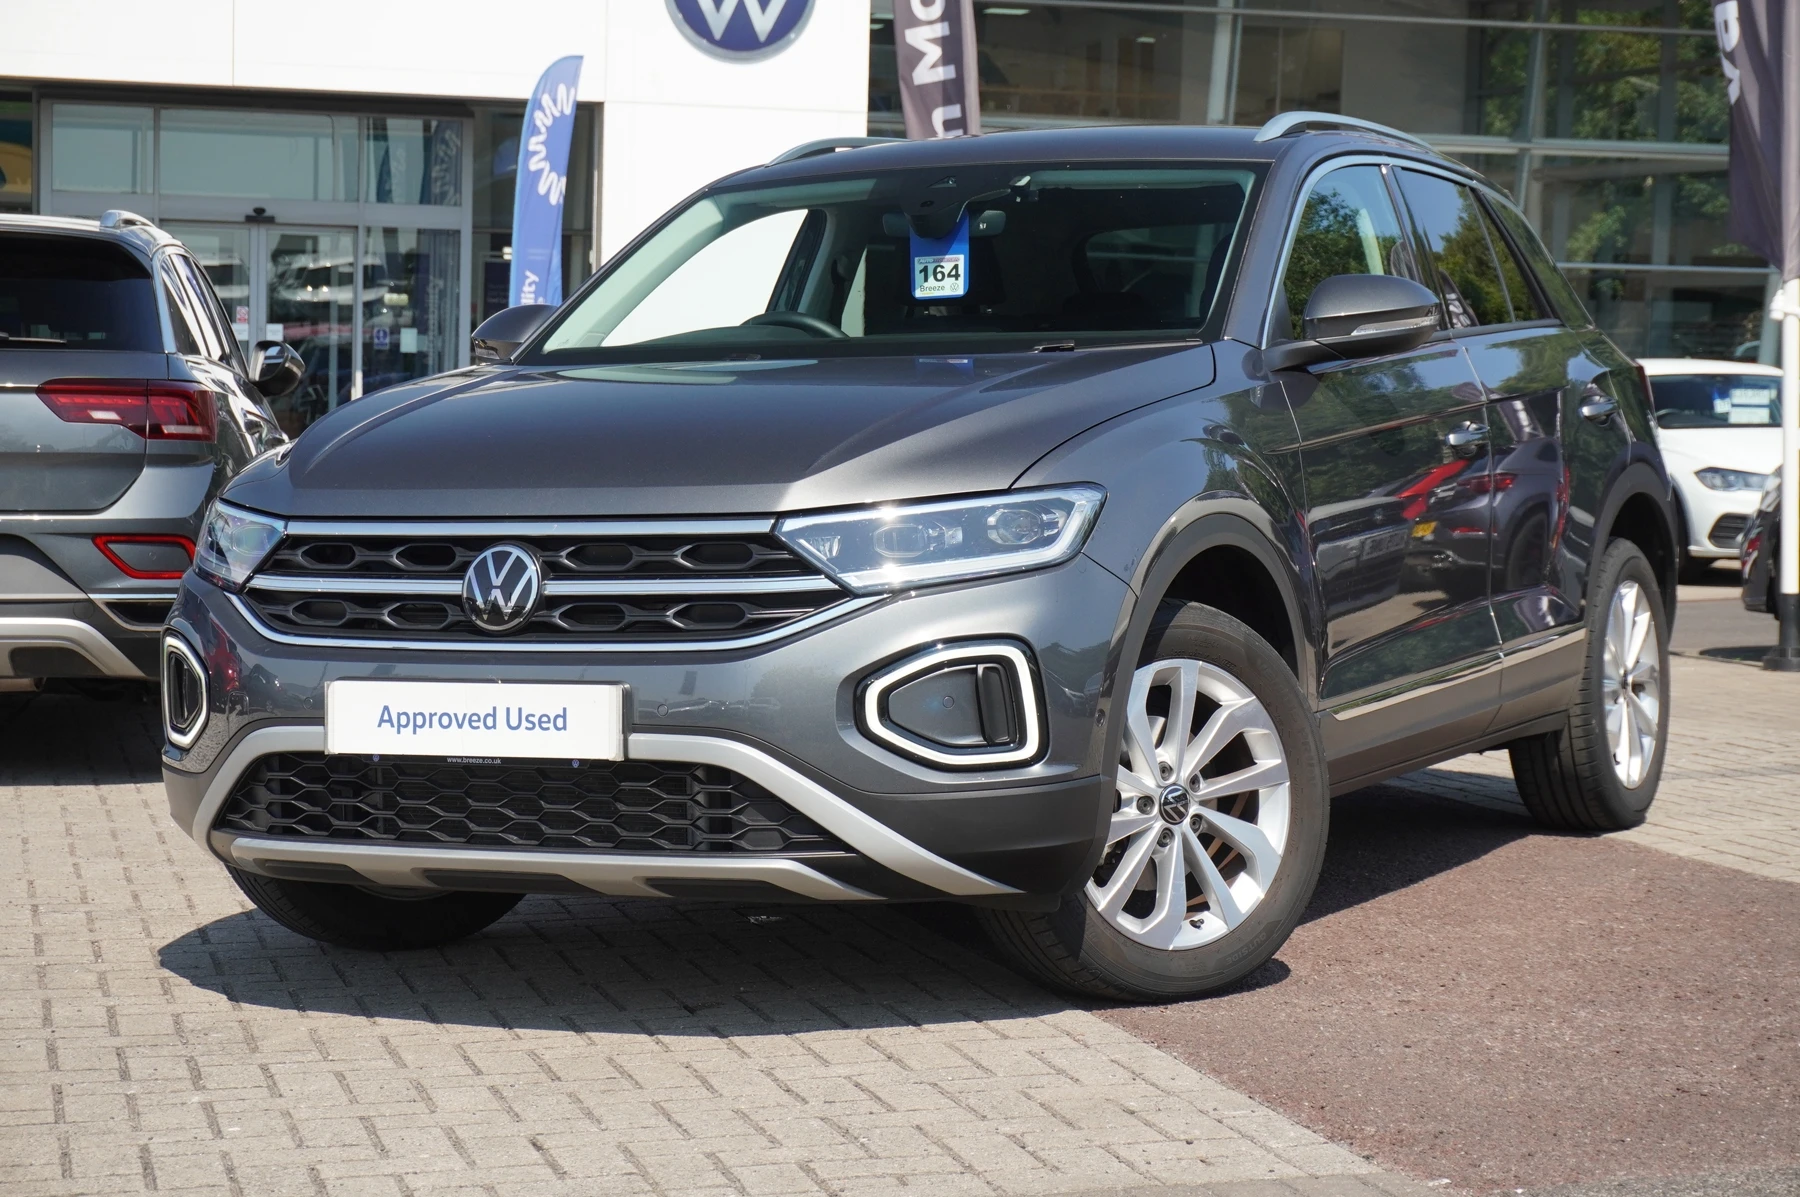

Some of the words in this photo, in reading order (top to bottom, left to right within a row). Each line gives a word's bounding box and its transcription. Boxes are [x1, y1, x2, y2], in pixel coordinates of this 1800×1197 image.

[919, 264, 960, 282] 164
[919, 284, 946, 292] Breeze
[377, 705, 497, 735] Approved
[505, 706, 568, 731] Used
[446, 756, 502, 765] www.breeze.co.uk
